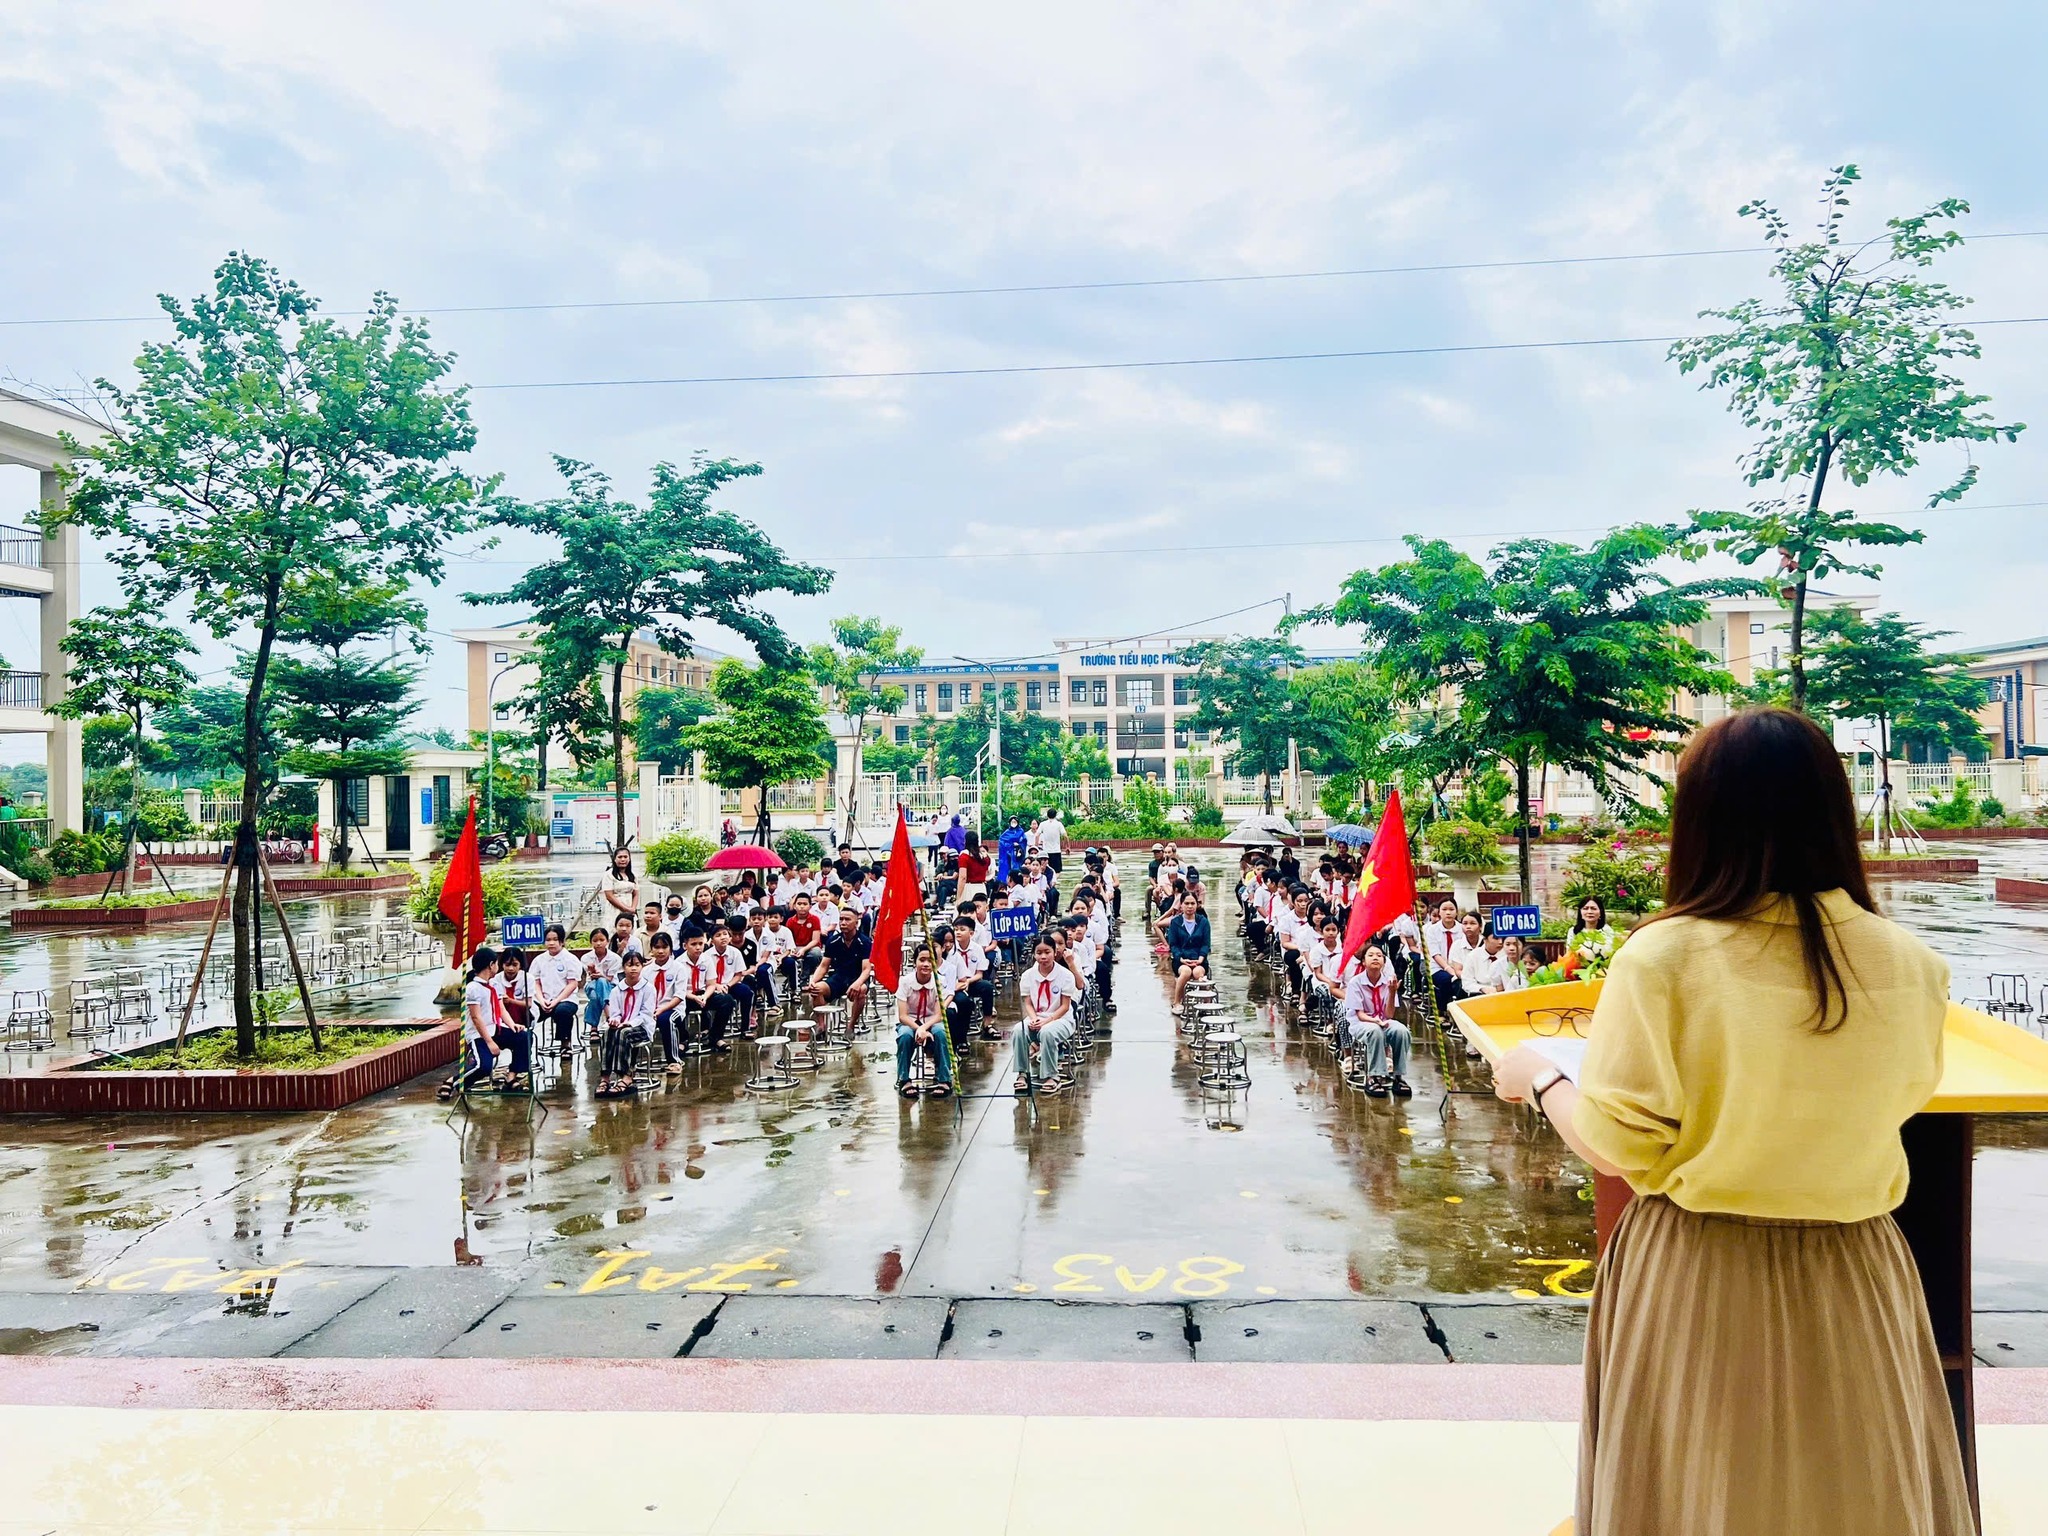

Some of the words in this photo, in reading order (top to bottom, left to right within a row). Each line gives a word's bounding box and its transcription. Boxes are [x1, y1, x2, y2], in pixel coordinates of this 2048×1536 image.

[1080, 652, 1116, 666] TRƯỜNG
[1118, 650, 1139, 666] TIỂU
[1141, 654, 1159, 667] HỌC
[1136, 705, 1145, 713] A2
[506, 920, 523, 940] LỚP
[524, 923, 541, 939] 6A1
[994, 913, 1012, 933] LỚP
[1013, 915, 1032, 932] 6A2
[1496, 910, 1515, 931] LỚP
[1516, 913, 1536, 930] 6A3
[1052, 1253, 1245, 1296] 8A3
